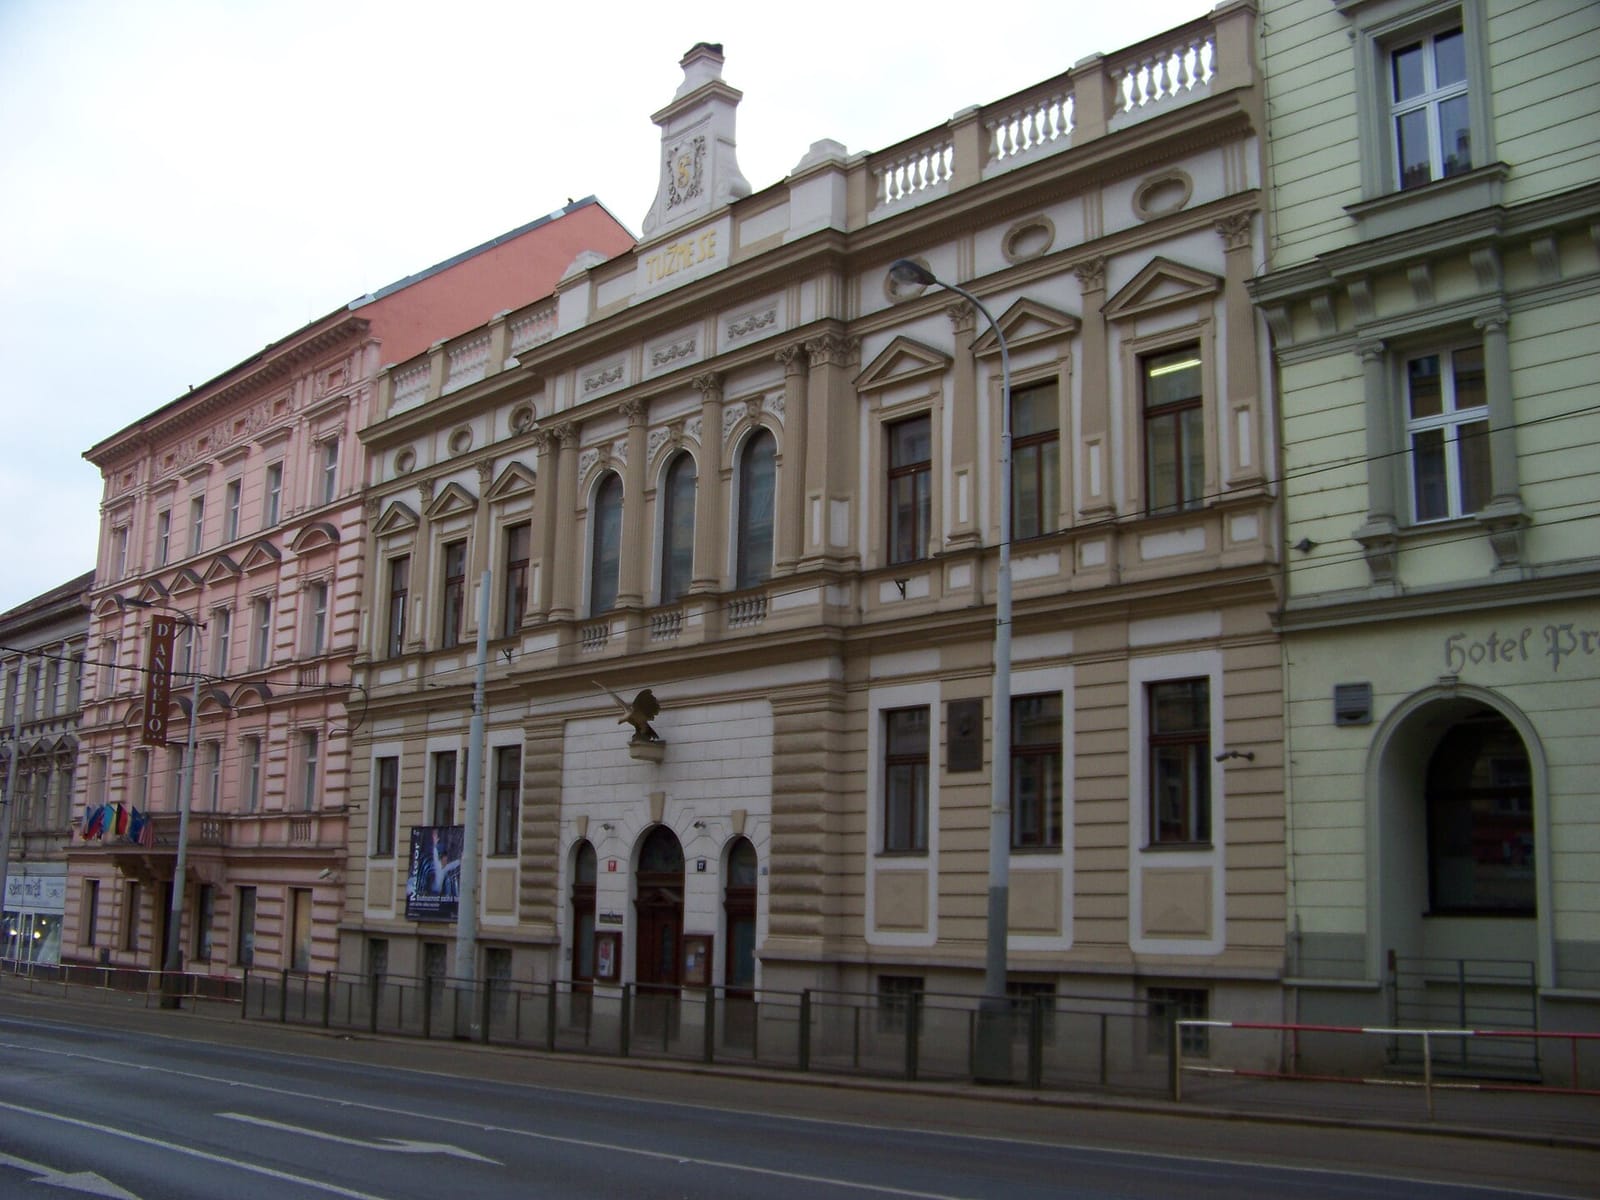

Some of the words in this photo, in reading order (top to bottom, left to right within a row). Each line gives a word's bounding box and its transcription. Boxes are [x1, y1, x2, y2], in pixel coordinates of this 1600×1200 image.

[697, 228, 717, 264] SE
[1445, 627, 1531, 674] Hotel
[1543, 623, 1600, 672] Pr
